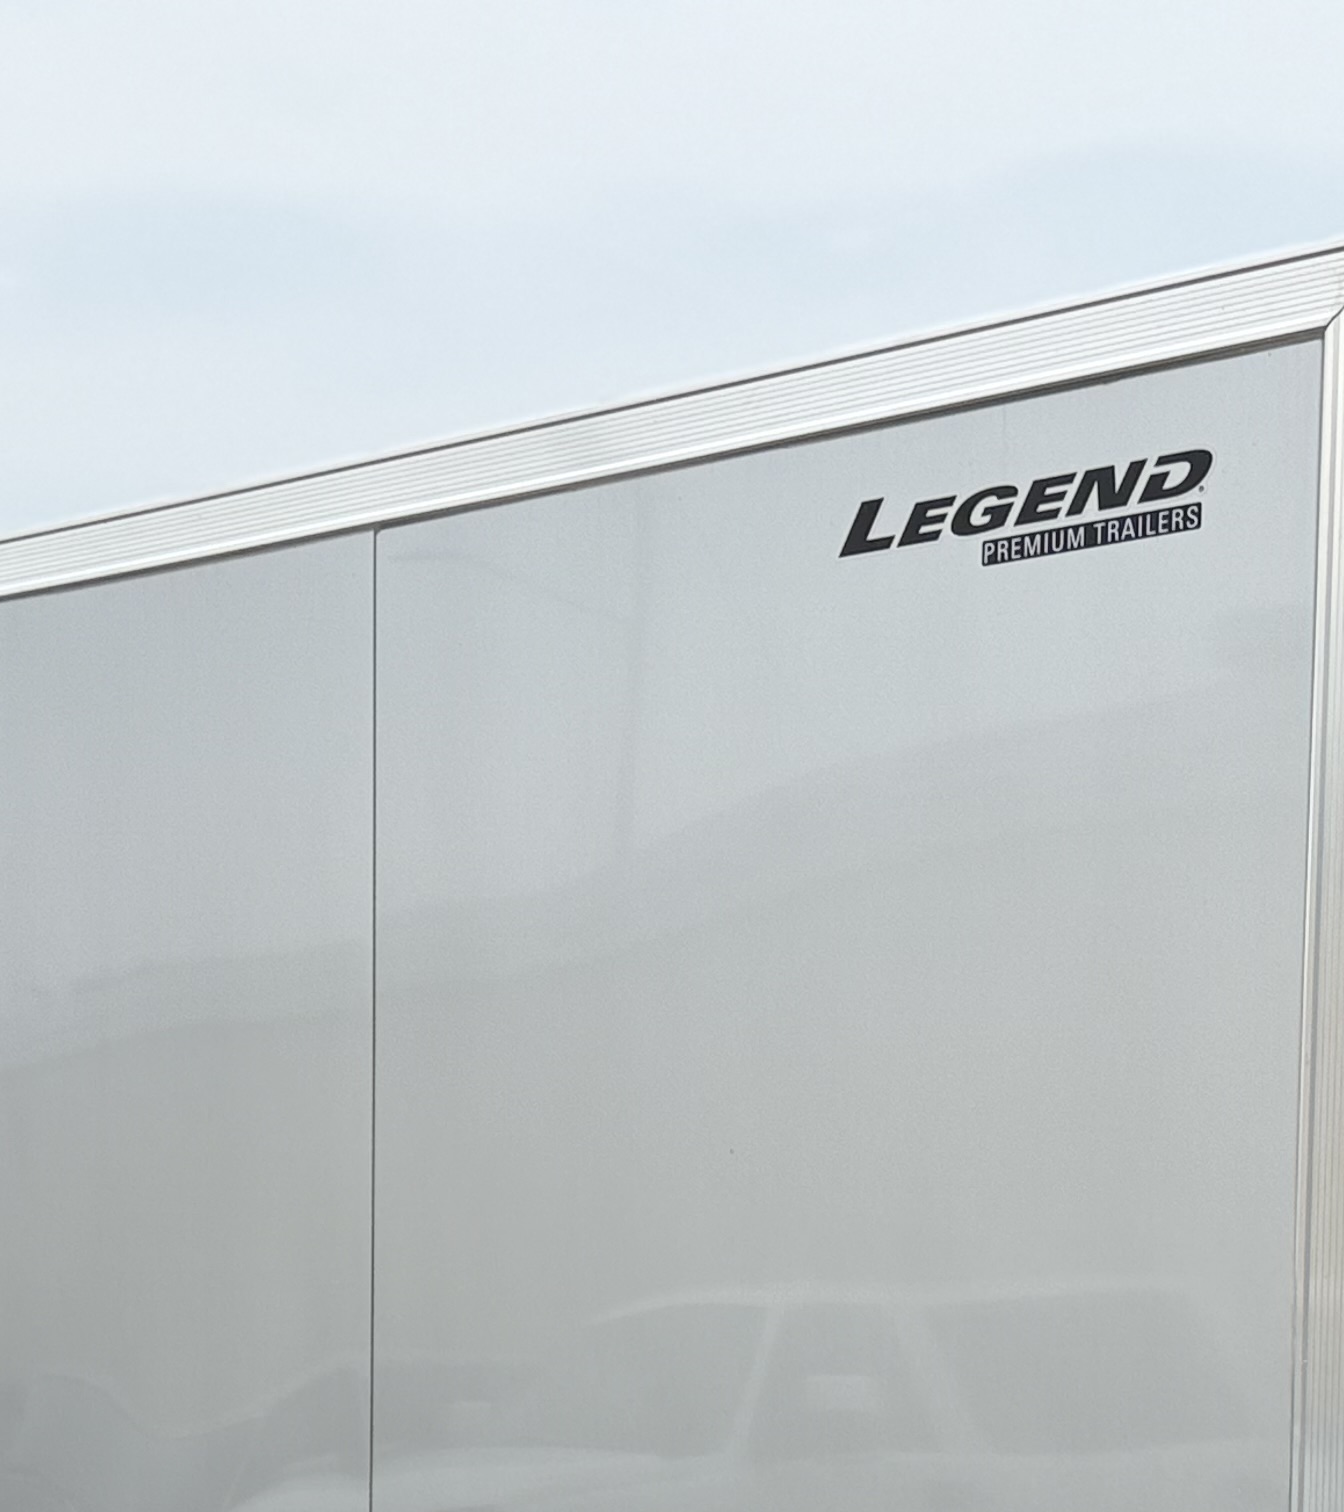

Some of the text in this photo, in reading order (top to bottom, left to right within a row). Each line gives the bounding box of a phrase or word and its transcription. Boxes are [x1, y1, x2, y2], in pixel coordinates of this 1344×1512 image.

[839, 449, 1214, 558] LEGEND
[983, 506, 1200, 565] PREMIUM TRAILERS
